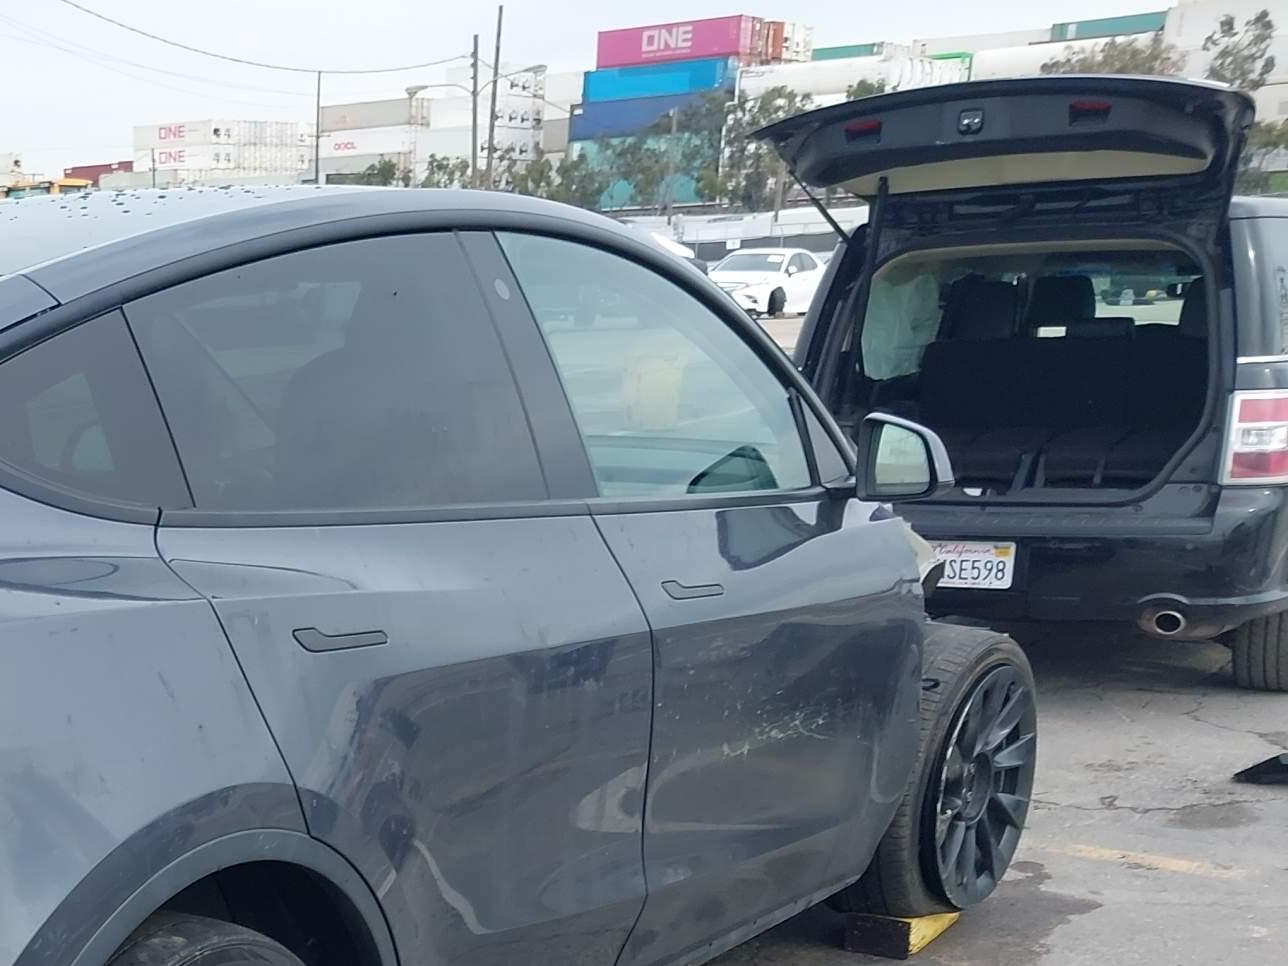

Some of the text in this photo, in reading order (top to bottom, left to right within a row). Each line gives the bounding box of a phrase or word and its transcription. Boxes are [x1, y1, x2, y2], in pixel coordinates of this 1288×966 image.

[640, 25, 693, 52] ONE
[158, 125, 185, 140] ONE
[158, 150, 185, 165] ONE
[935, 543, 992, 558] California
[942, 559, 1007, 581] SE598
